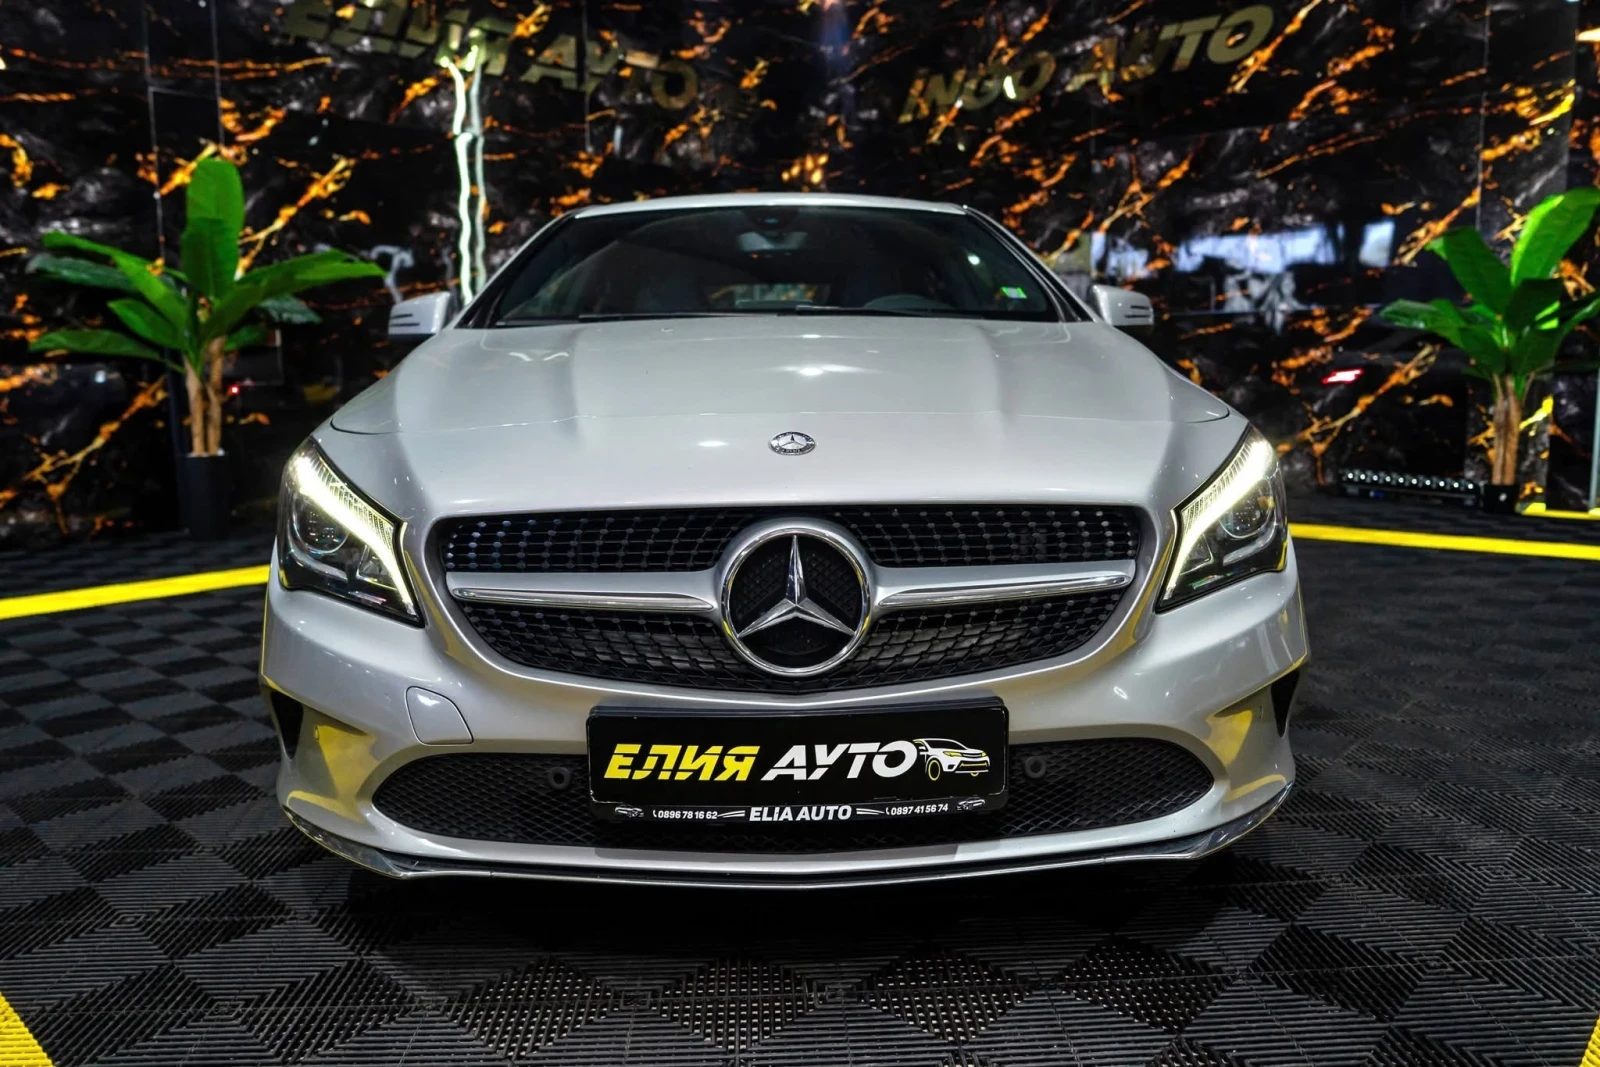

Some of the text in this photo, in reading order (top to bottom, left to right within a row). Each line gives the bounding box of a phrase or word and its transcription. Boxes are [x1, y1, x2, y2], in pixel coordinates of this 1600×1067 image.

[1064, 4, 1274, 95] AUTO
[603, 740, 918, 781] ЕЛИЯ АУТО
[657, 810, 681, 819] 0896
[749, 805, 852, 821] ELIA AUTO
[890, 806, 913, 815] 0897
